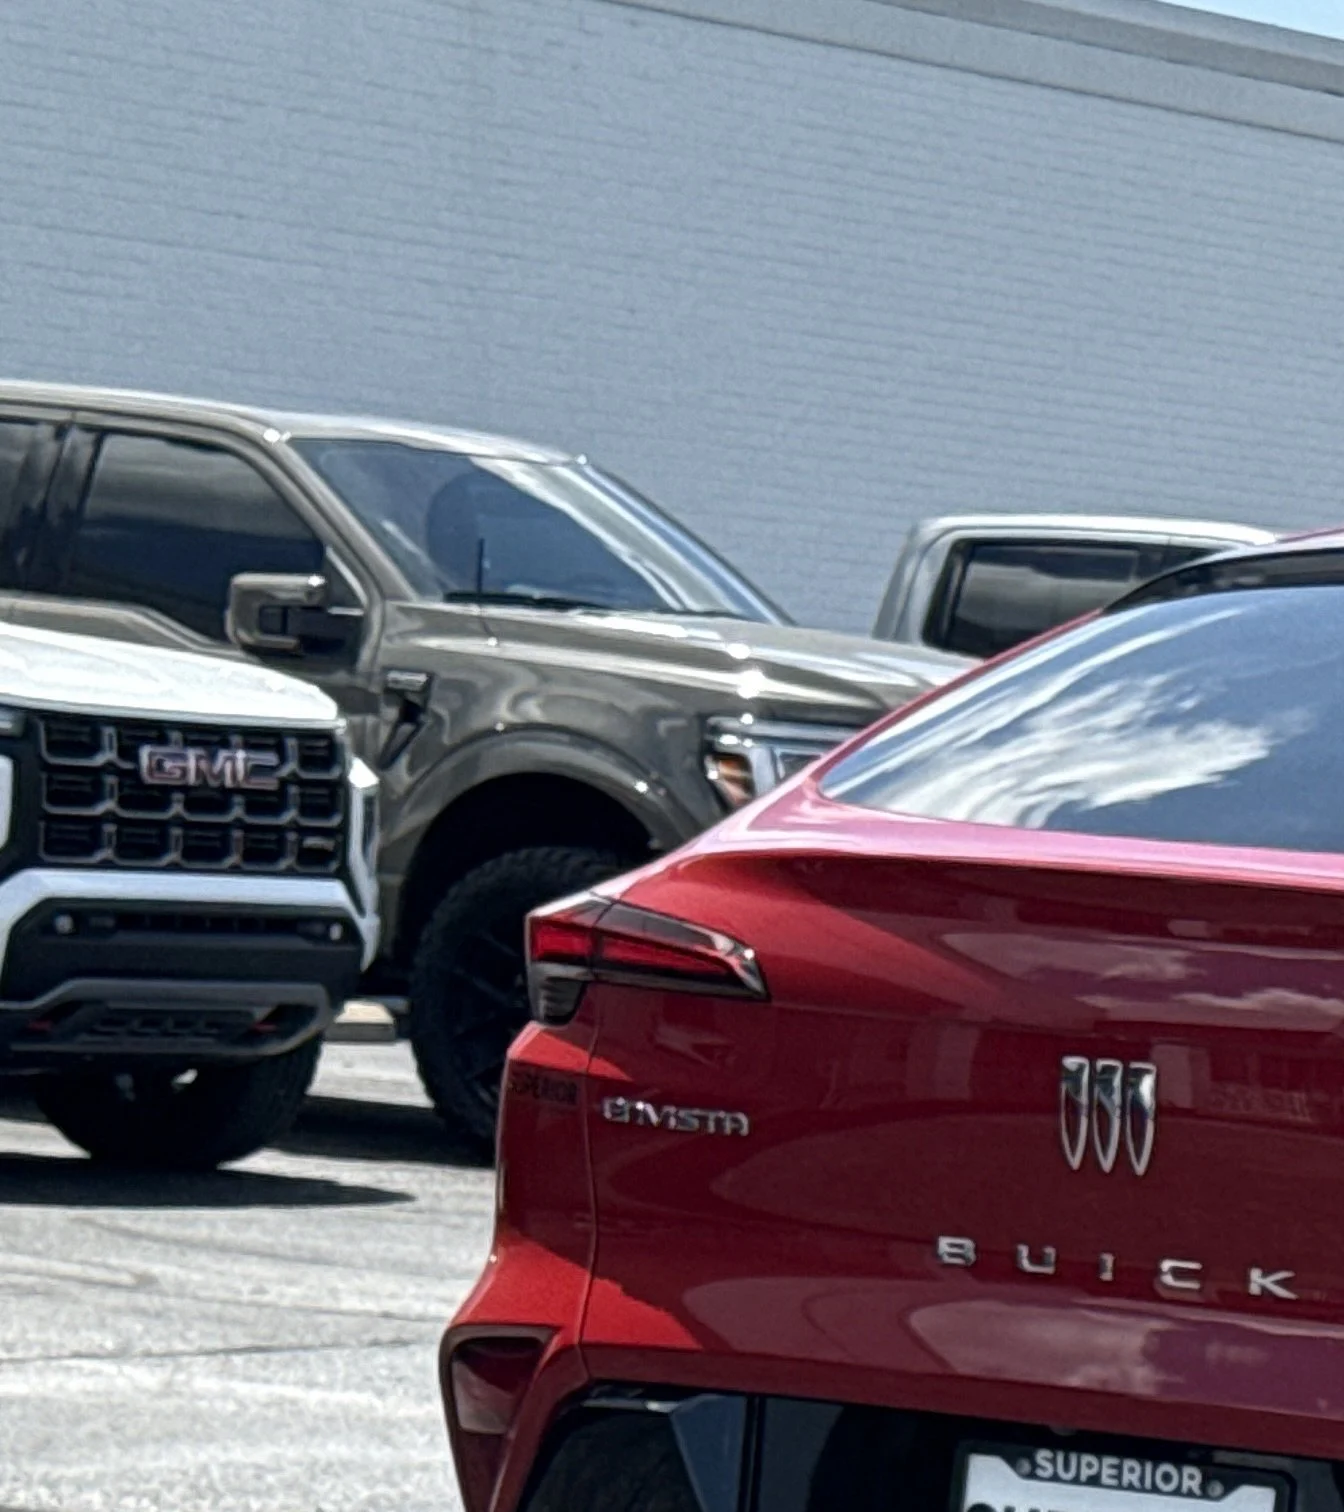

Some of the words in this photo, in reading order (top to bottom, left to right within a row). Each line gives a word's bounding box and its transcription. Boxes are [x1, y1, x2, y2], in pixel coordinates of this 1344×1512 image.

[139, 744, 280, 790] GMC
[937, 1235, 1299, 1300] BUICK
[1033, 1448, 1203, 1497] SUPERIOR
